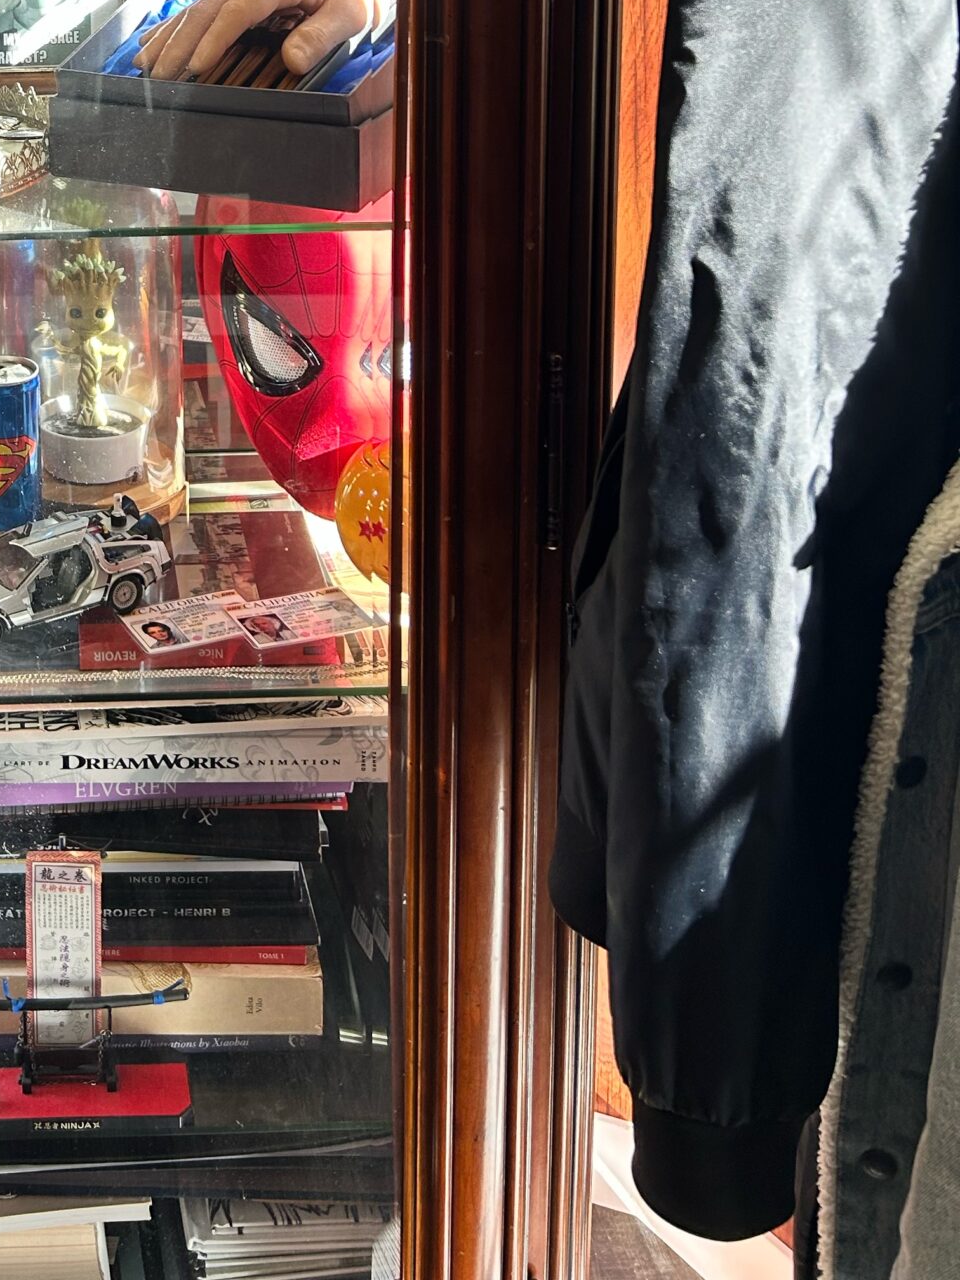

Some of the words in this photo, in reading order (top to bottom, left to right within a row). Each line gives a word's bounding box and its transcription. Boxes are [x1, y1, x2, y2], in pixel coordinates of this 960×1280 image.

[136, 593, 220, 615] CALIFORNIA
[243, 591, 325, 609] CALIFORNIA
[93, 650, 137, 662] REVOIR
[198, 648, 224, 659] Nice
[246, 758, 341, 766] ANIMATION
[74, 781, 178, 799] ELVGREN
[129, 875, 161, 884] INKED
[165, 875, 209, 884] PROJECT
[102, 907, 157, 918] ROJECT
[173, 907, 216, 918] HENRI
[221, 907, 231, 917] B
[257, 951, 279, 959] TOME
[198, 1038, 210, 1050] by
[212, 1036, 249, 1048] Xiaobai
[60, 1121, 92, 1130] NINJA
